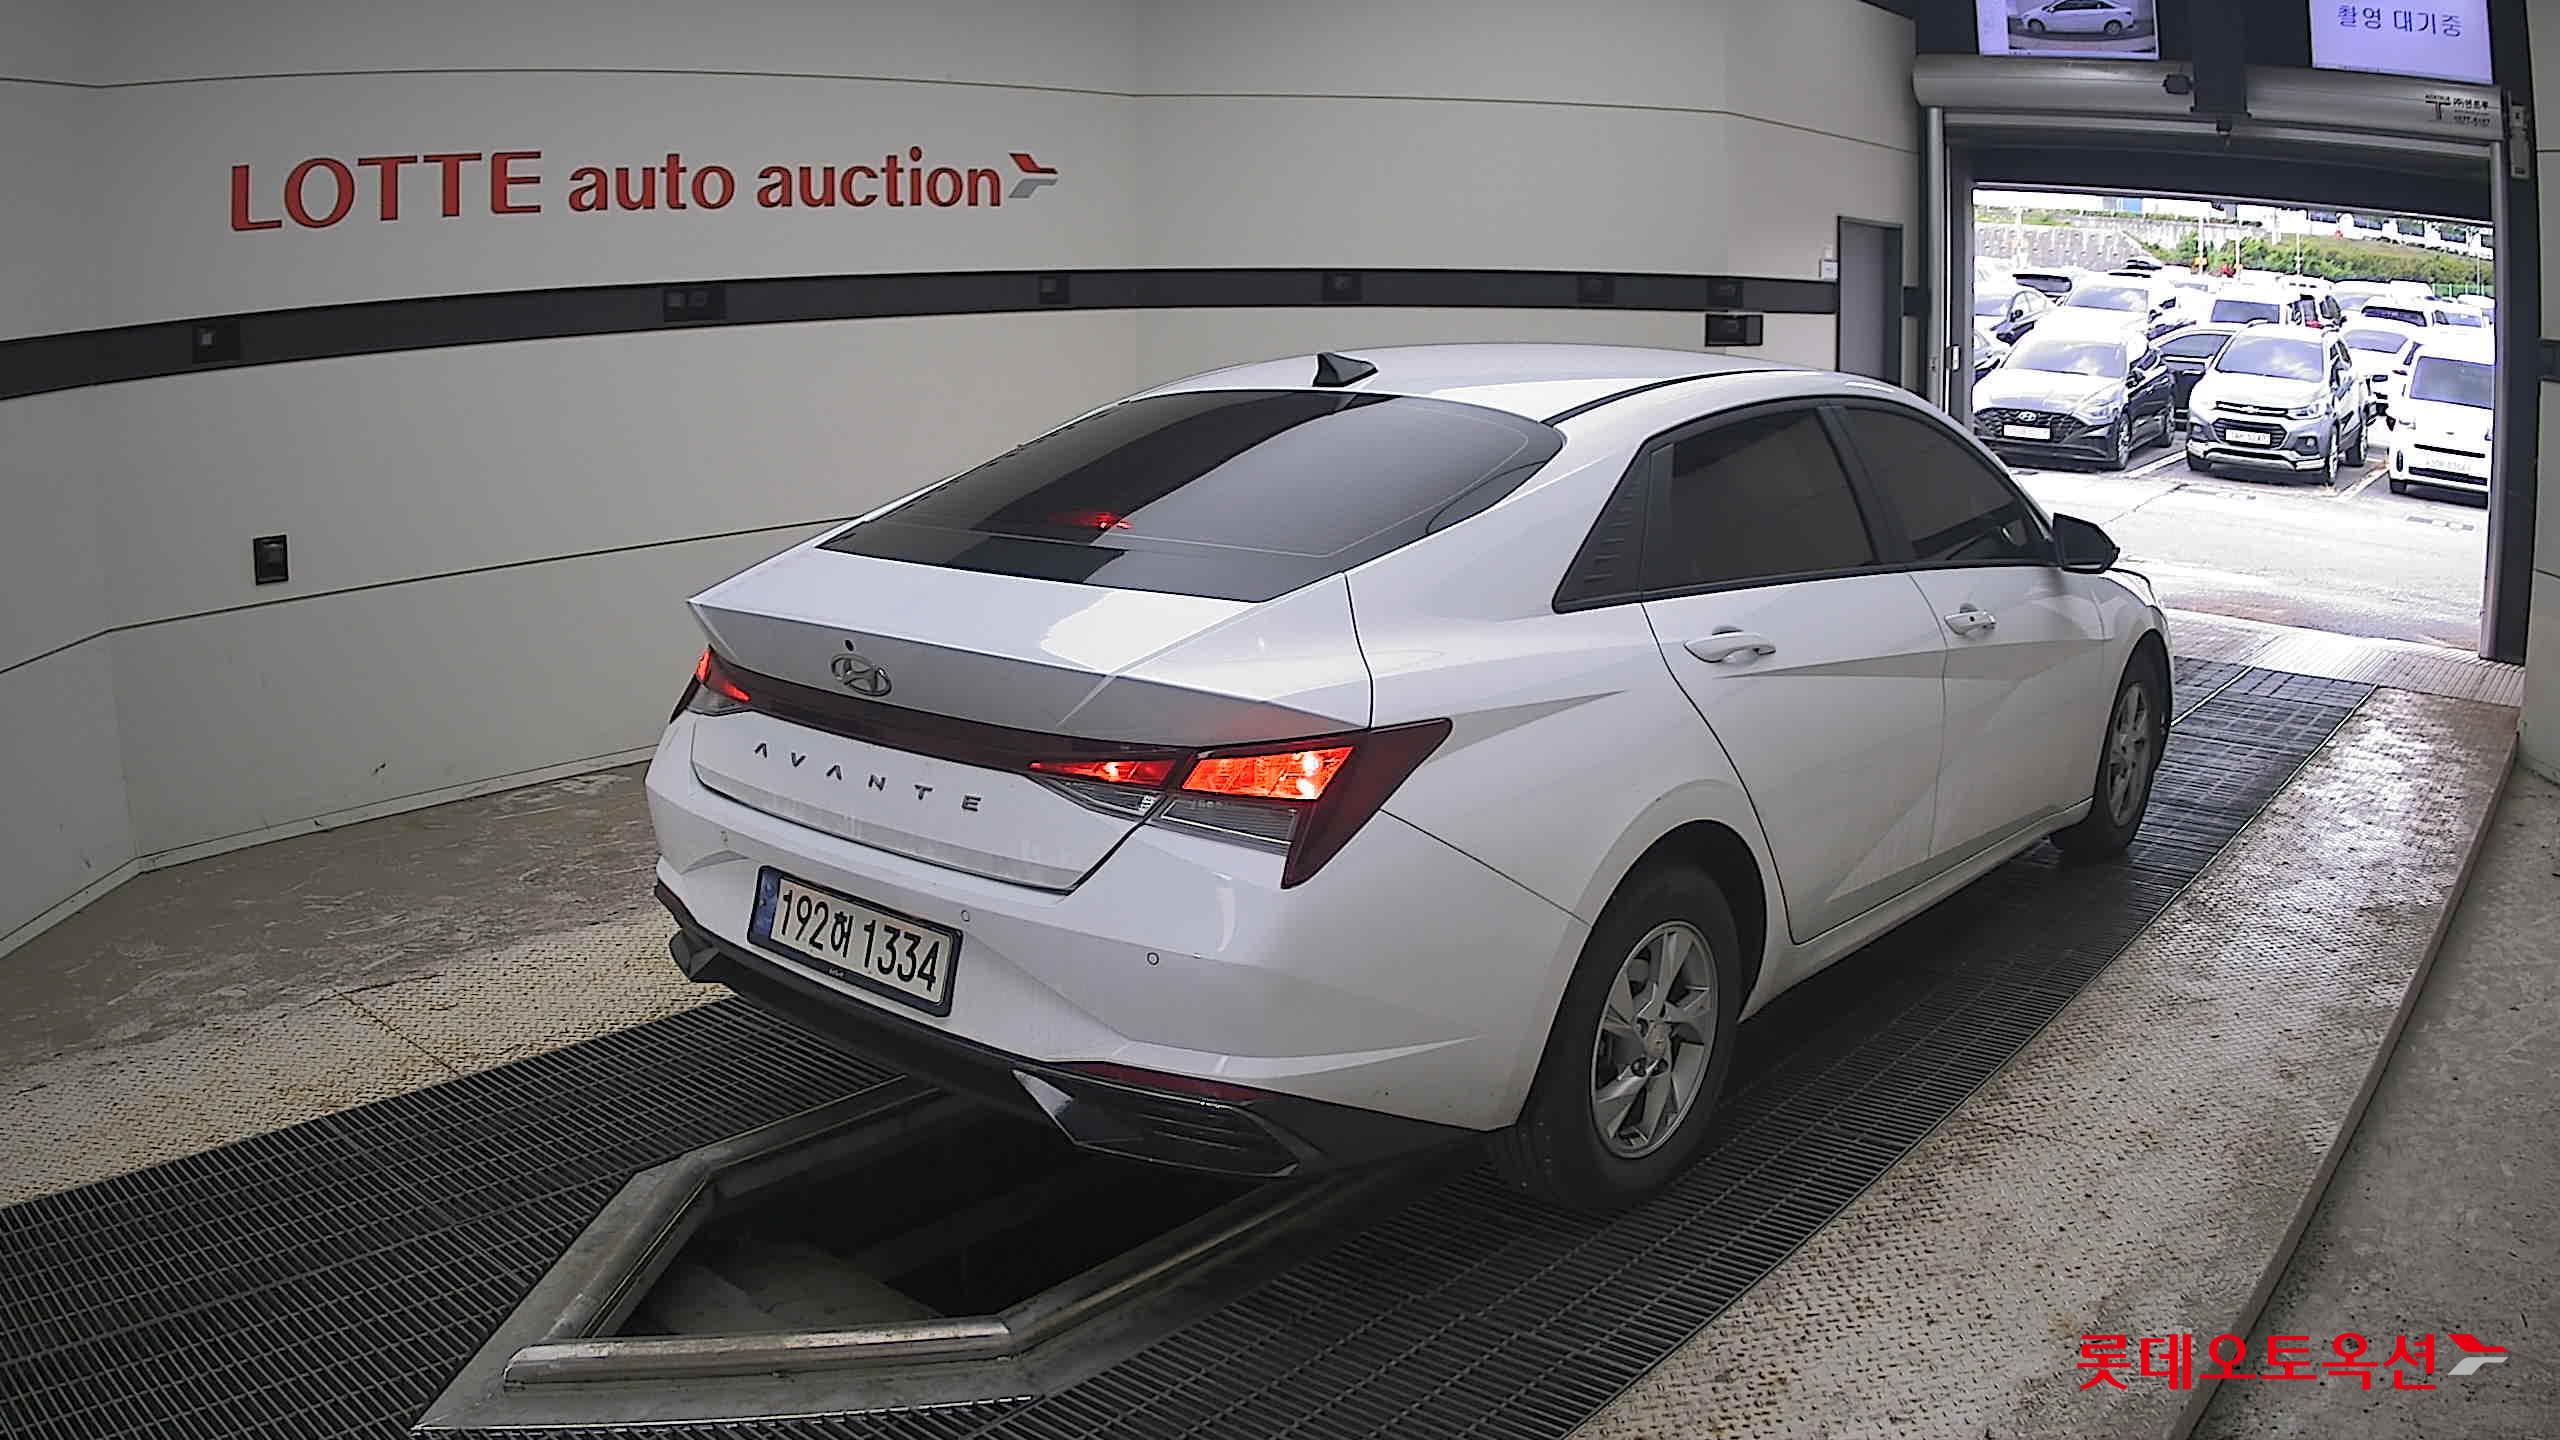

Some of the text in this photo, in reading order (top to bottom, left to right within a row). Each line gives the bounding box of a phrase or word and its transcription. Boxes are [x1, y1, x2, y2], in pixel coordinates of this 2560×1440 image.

[2338, 5, 2462, 37] 촬영 대기중
[231, 146, 1001, 231] LOTTE auto auction
[754, 742, 982, 812] AVANTE
[781, 889, 940, 992] 192허 1334
